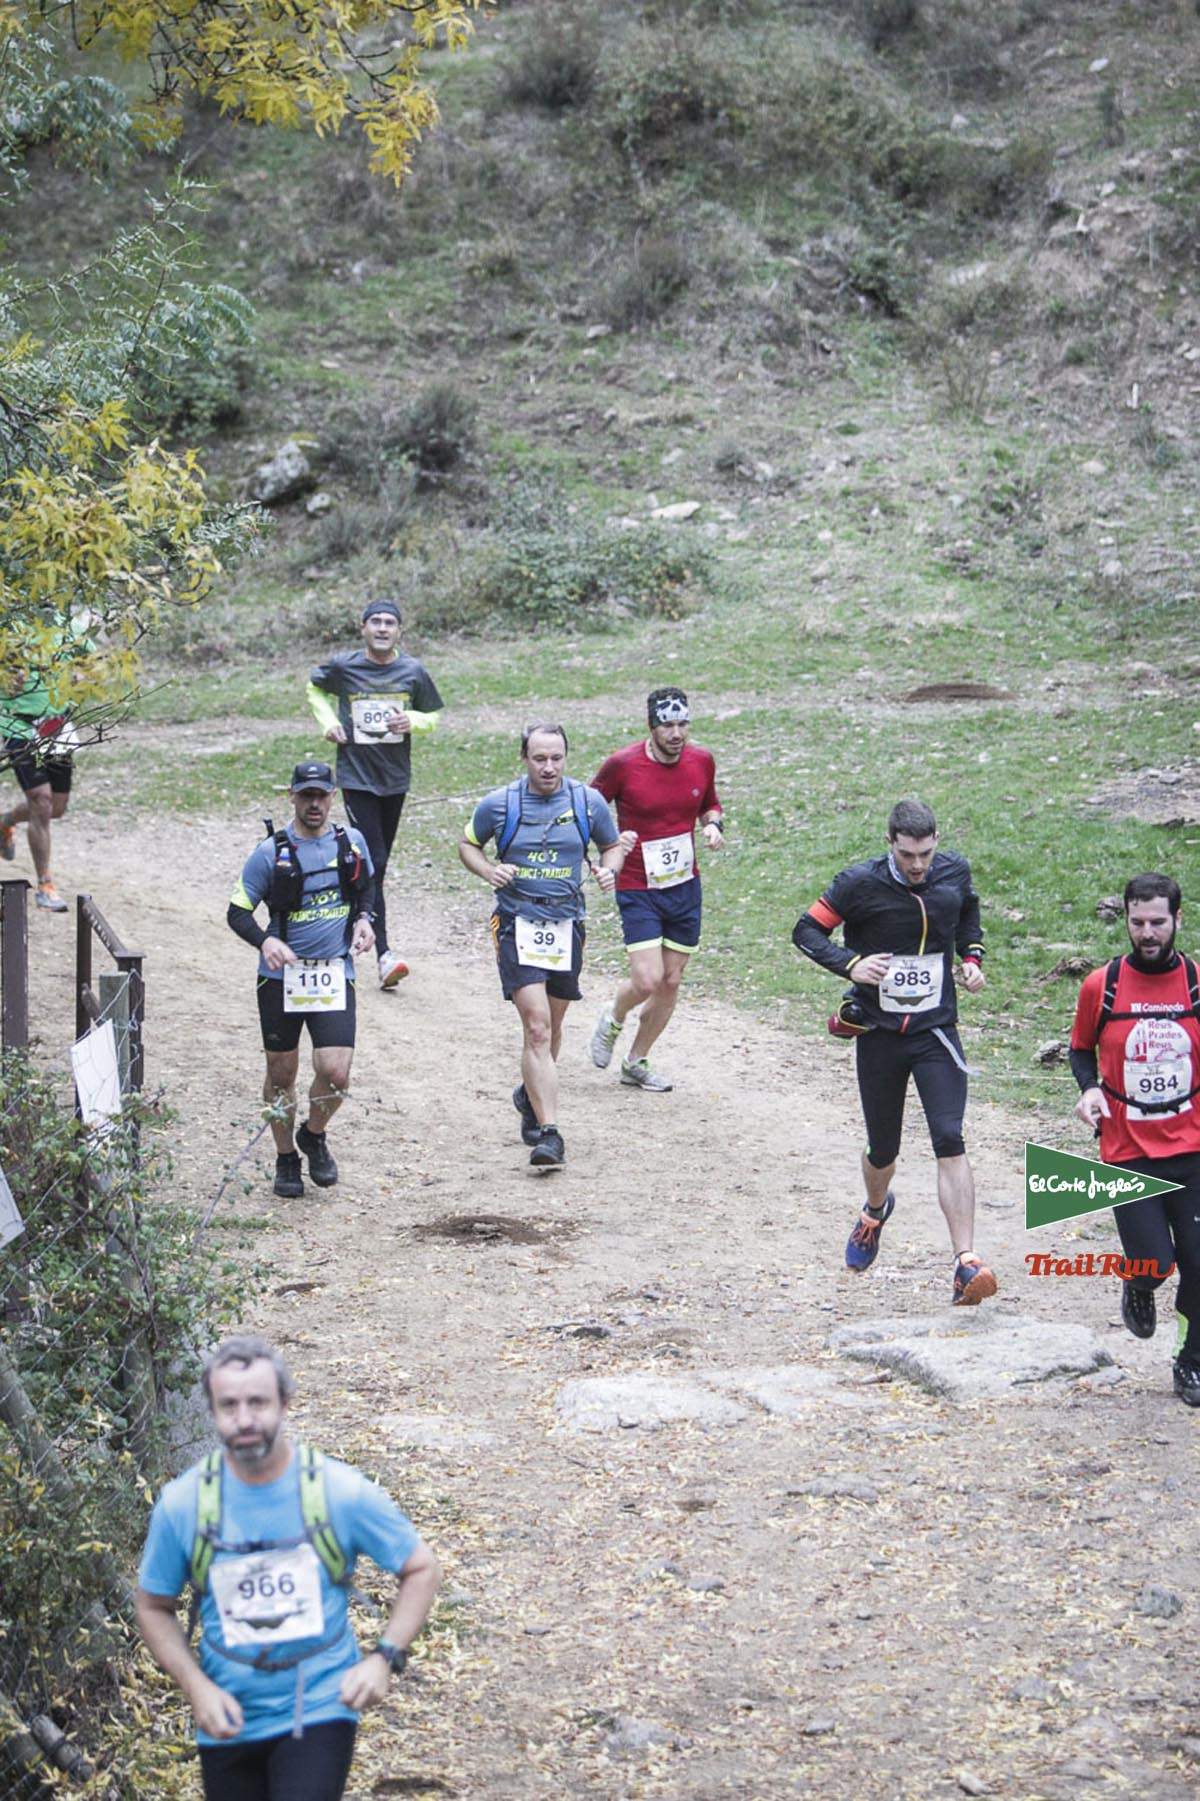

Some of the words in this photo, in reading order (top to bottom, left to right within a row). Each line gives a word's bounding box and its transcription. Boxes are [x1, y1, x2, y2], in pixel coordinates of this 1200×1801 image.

[661, 850, 680, 865] 37
[533, 931, 556, 946] 39
[298, 973, 332, 987] 110
[894, 970, 932, 987] 983
[1148, 1020, 1173, 1029] Reus
[1148, 1030, 1183, 1039] Prades
[1148, 1040, 1173, 1049] Reus
[1139, 1074, 1179, 1093] 984
[237, 1572, 295, 1600] 966
